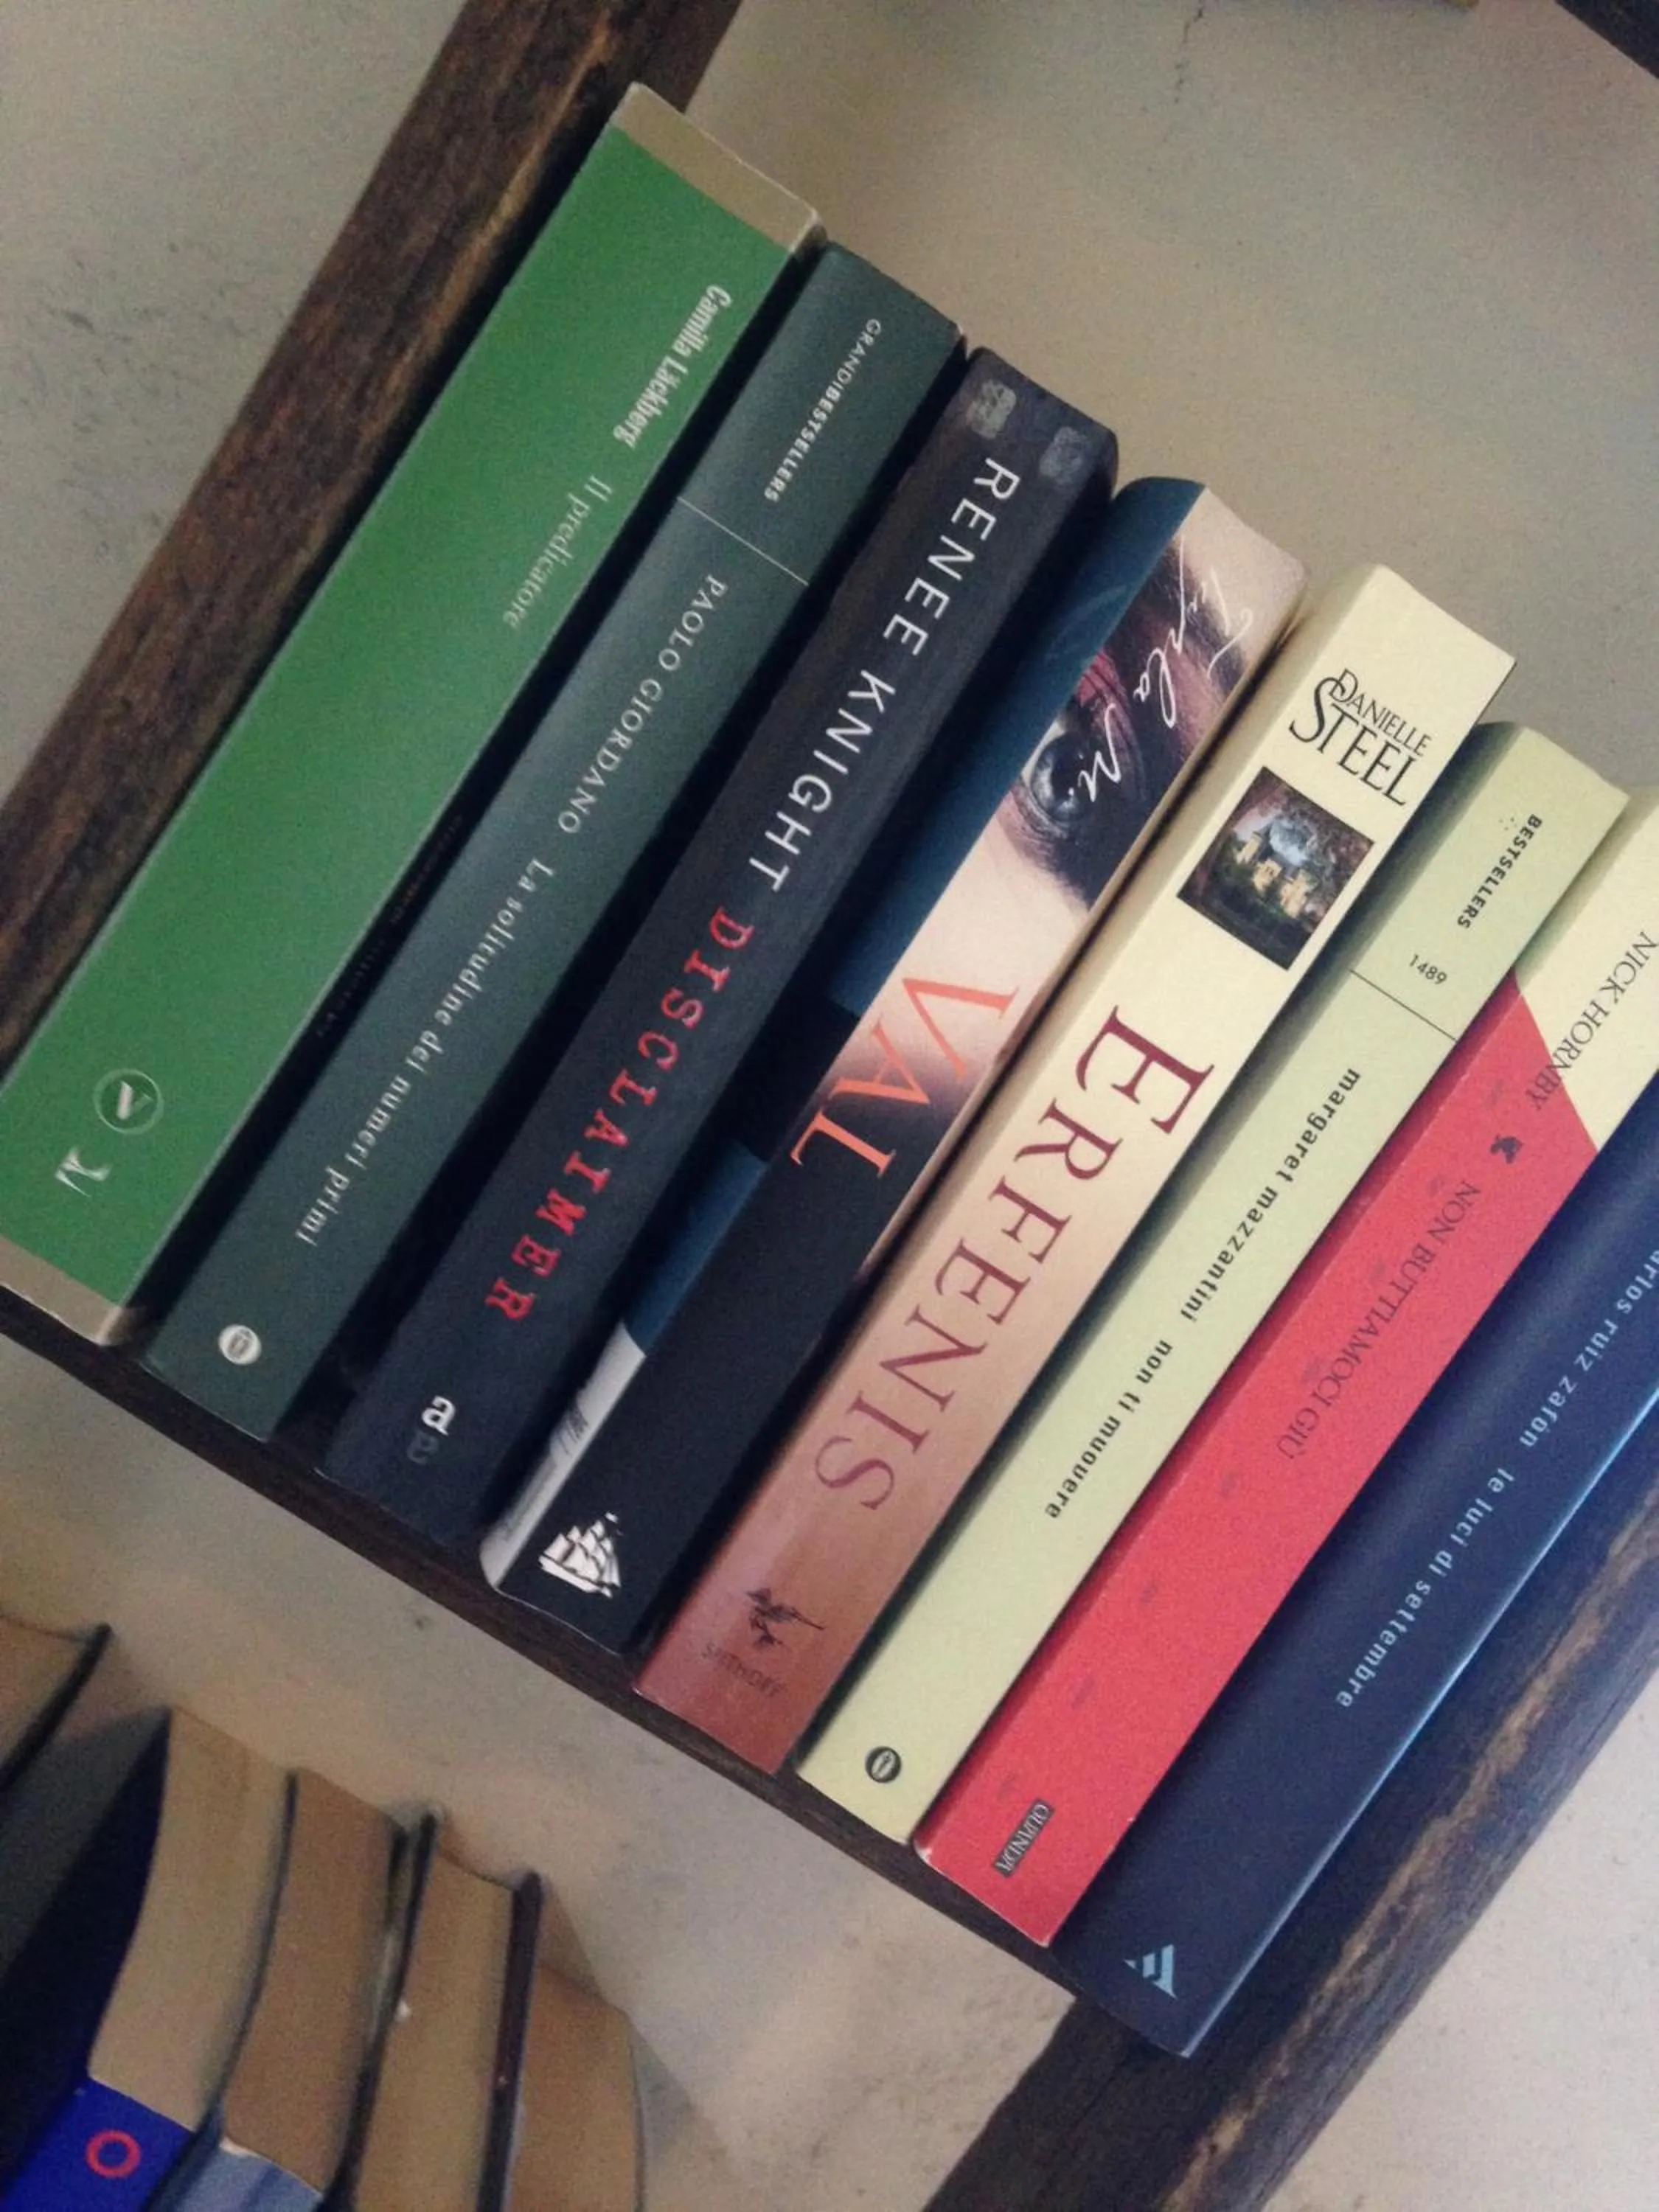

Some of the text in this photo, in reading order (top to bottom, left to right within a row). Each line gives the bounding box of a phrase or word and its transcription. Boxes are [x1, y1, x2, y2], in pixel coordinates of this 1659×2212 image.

[613, 285, 732, 448] Camilla Läckberg
[503, 474, 613, 628] Il predicatore
[557, 574, 728, 833] PAOLO GIORDANO
[748, 457, 1020, 891] RENEE KNIGHT
[1287, 676, 1418, 806] STEEL
[1326, 669, 1431, 757] DANIELLE
[1457, 813, 1542, 929] BESTSELLERS
[294, 857, 554, 1247] La solitudine dei numeri primi
[1408, 953, 1448, 985] 1489
[1526, 932, 1659, 1110] NICK HORNBY
[484, 907, 754, 1319] DISCLAIMER
[790, 977, 1018, 1178] VAL
[814, 1006, 1214, 1511] ERFENIS
[1179, 1068, 1360, 1324] margaret mazzantini
[1276, 1179, 1481, 1460] NON BUTTIAMOCI GIÙ
[1573, 1318, 1618, 1371] ruiz
[1044, 1339, 1173, 1519] non ti muovere
[1519, 1374, 1579, 1448] zafón
[1335, 1467, 1515, 1708] le luci di settembre
